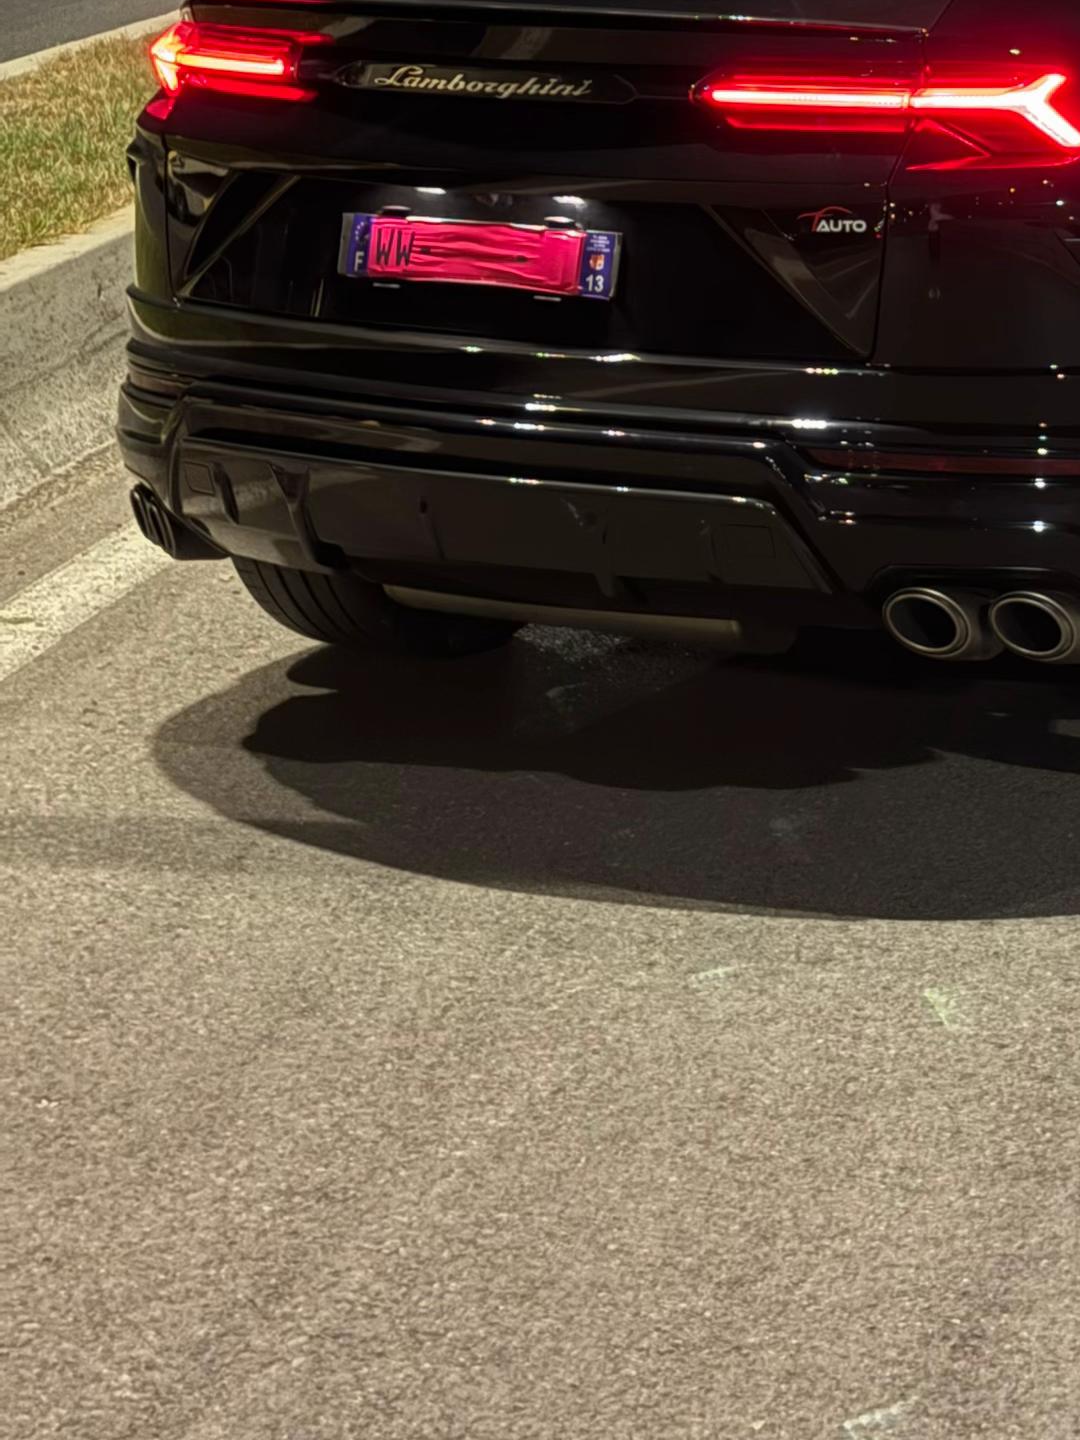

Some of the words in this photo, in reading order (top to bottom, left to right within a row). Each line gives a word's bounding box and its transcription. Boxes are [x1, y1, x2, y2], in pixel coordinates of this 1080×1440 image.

[373, 65, 593, 99] Lamborghini
[354, 251, 365, 272] F
[585, 274, 604, 293] 13
